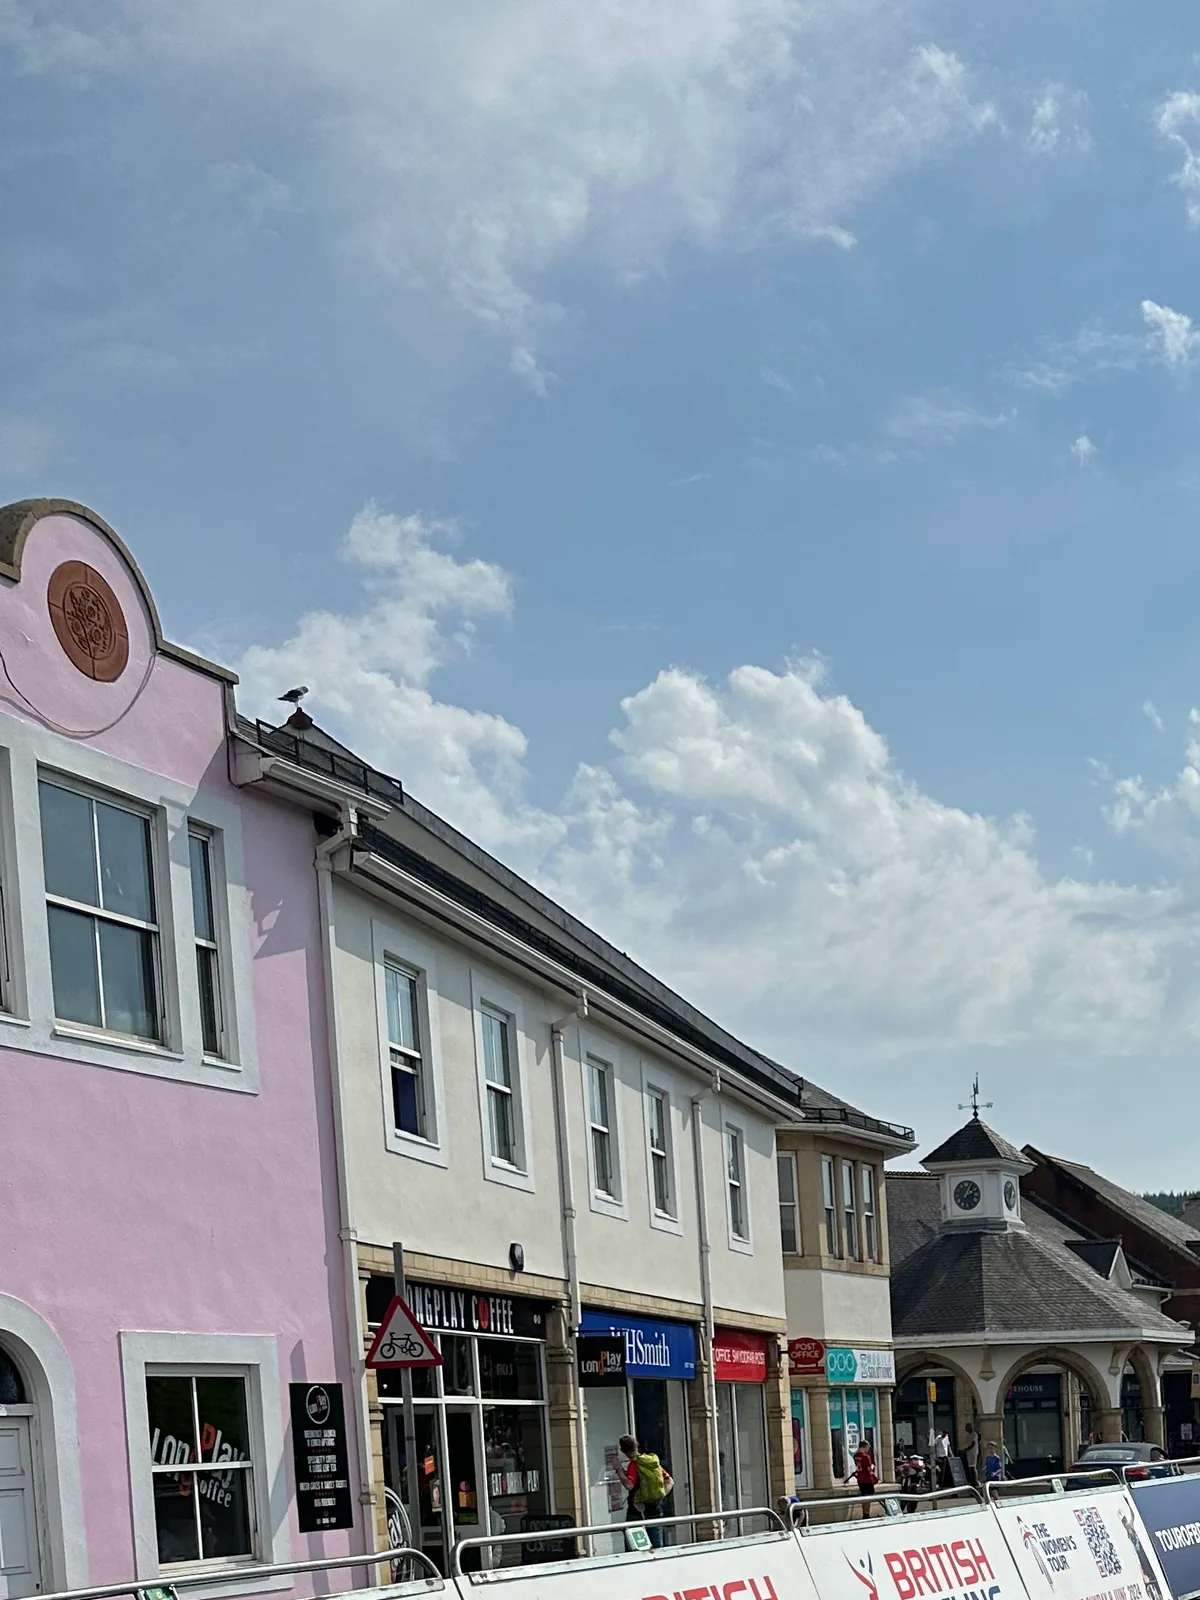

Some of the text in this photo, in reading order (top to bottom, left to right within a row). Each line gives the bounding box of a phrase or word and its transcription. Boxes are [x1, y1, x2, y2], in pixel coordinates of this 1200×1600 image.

[406, 1284, 514, 1334] ONGPLAY COFFEE
[790, 1350, 820, 1359] OFFICE
[795, 1342, 817, 1351] POST
[199, 1479, 233, 1508] offee
[1032, 1522, 1051, 1539] THE
[1039, 1535, 1078, 1556] WOMEN'S
[883, 1537, 996, 1600] BRITISH
[1047, 1555, 1071, 1573] TOUR
